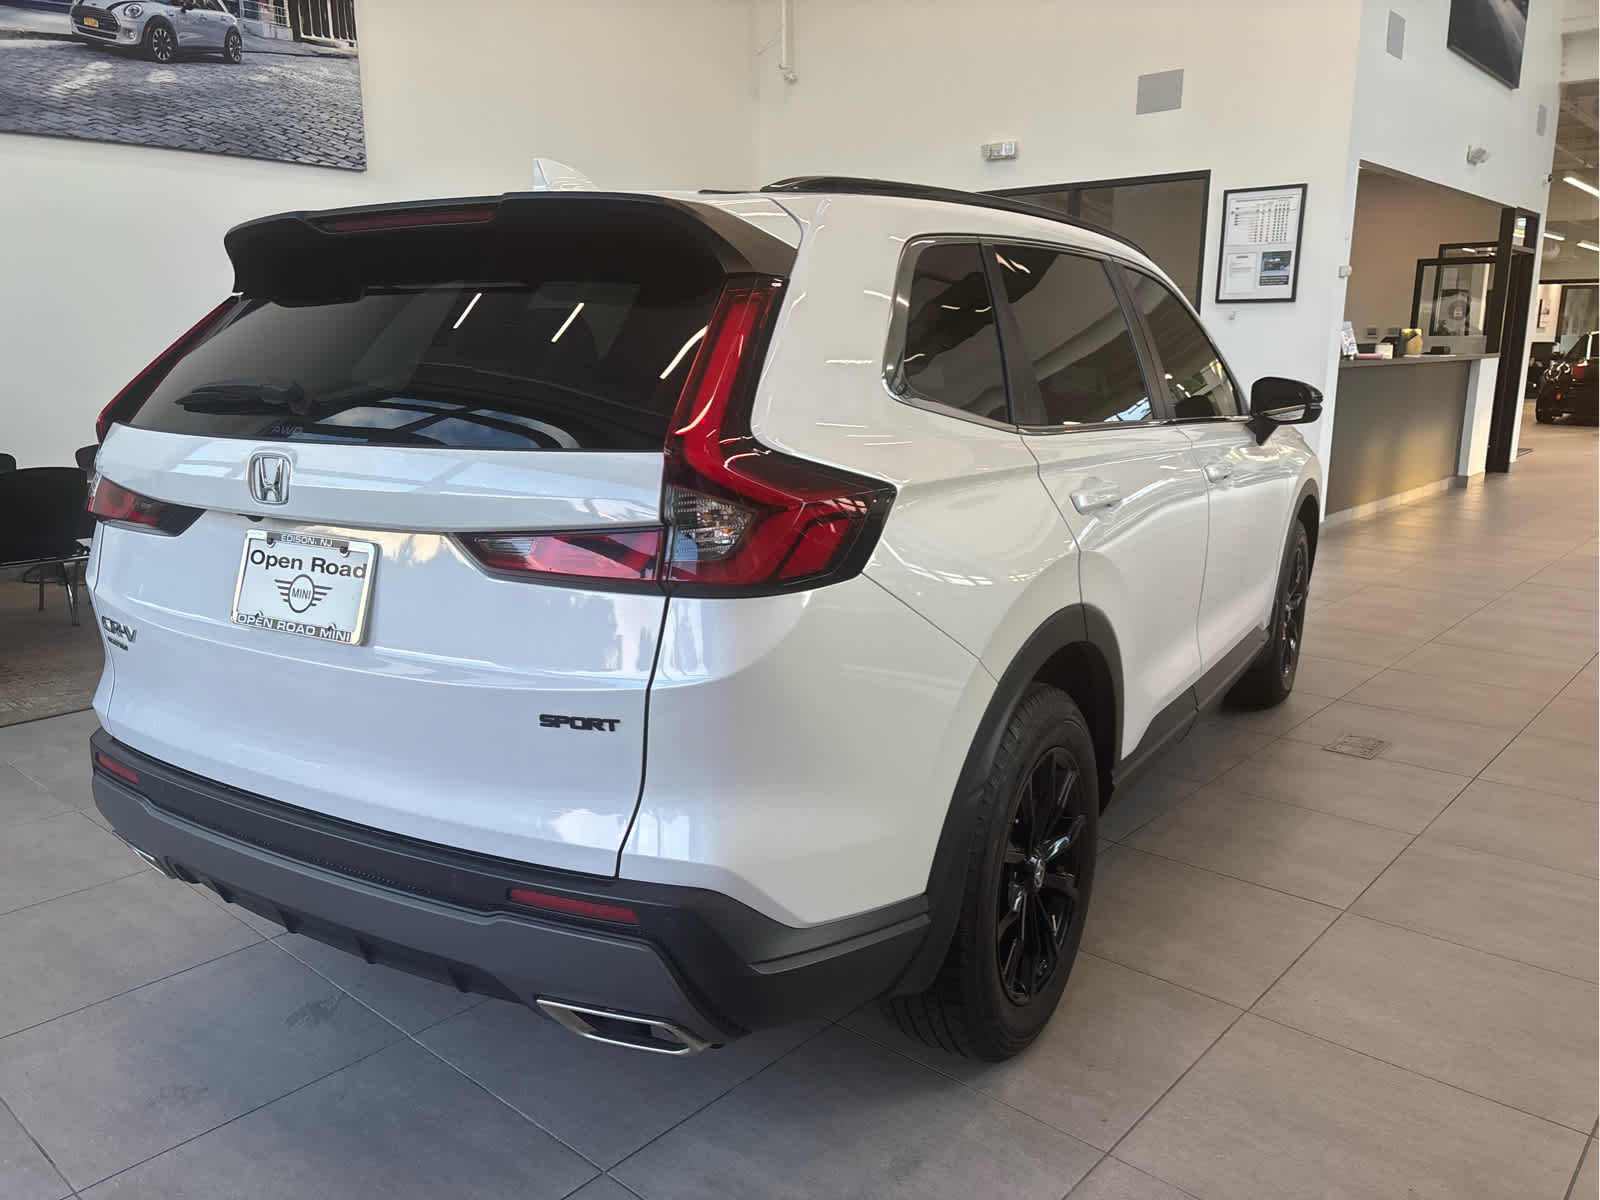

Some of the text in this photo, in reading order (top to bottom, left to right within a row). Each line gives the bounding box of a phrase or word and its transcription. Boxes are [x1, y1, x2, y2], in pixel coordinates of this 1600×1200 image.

[320, 537, 333, 546] NJ
[250, 549, 367, 579] Open Road
[291, 587, 312, 600] MINI
[238, 614, 351, 643] OPEN ROAD MINI
[539, 713, 621, 732] SPORT
